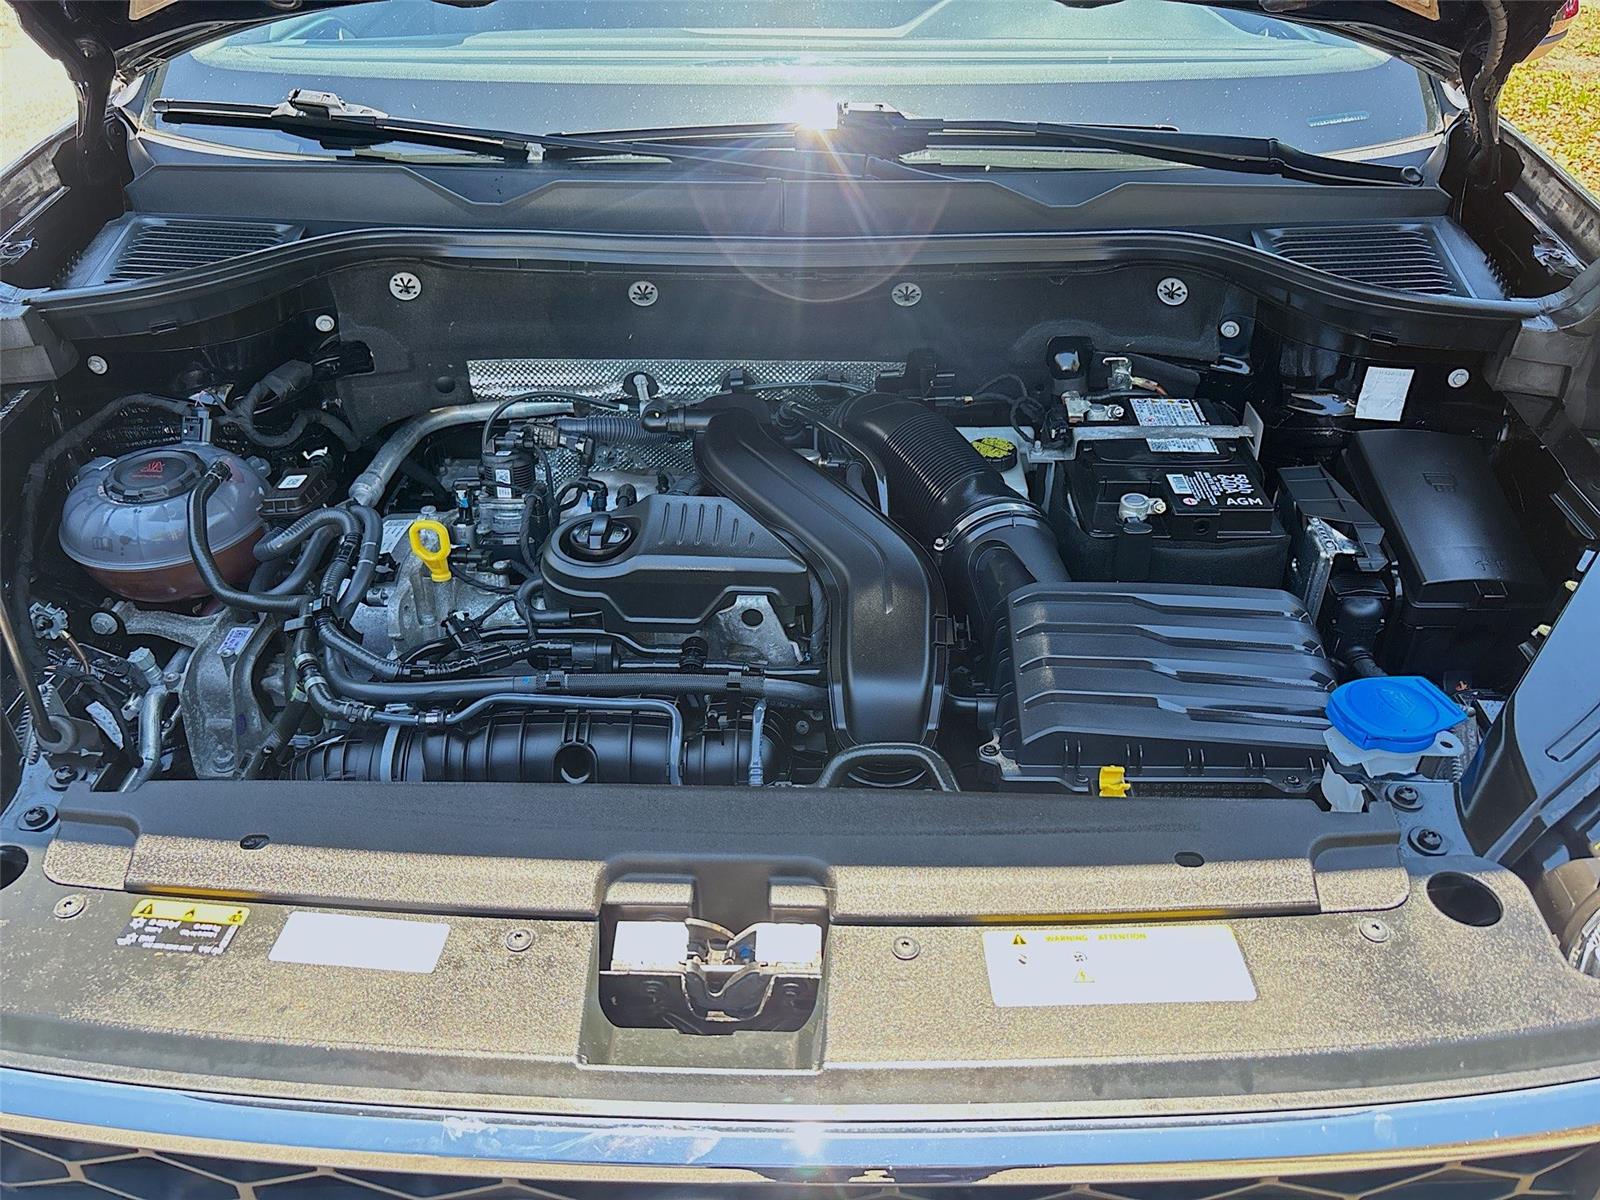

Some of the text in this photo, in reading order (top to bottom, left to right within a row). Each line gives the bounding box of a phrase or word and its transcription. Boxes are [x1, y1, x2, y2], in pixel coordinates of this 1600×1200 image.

[1226, 497, 1263, 505] AGM
[1045, 932, 1147, 943] WARNING ATTENTION
